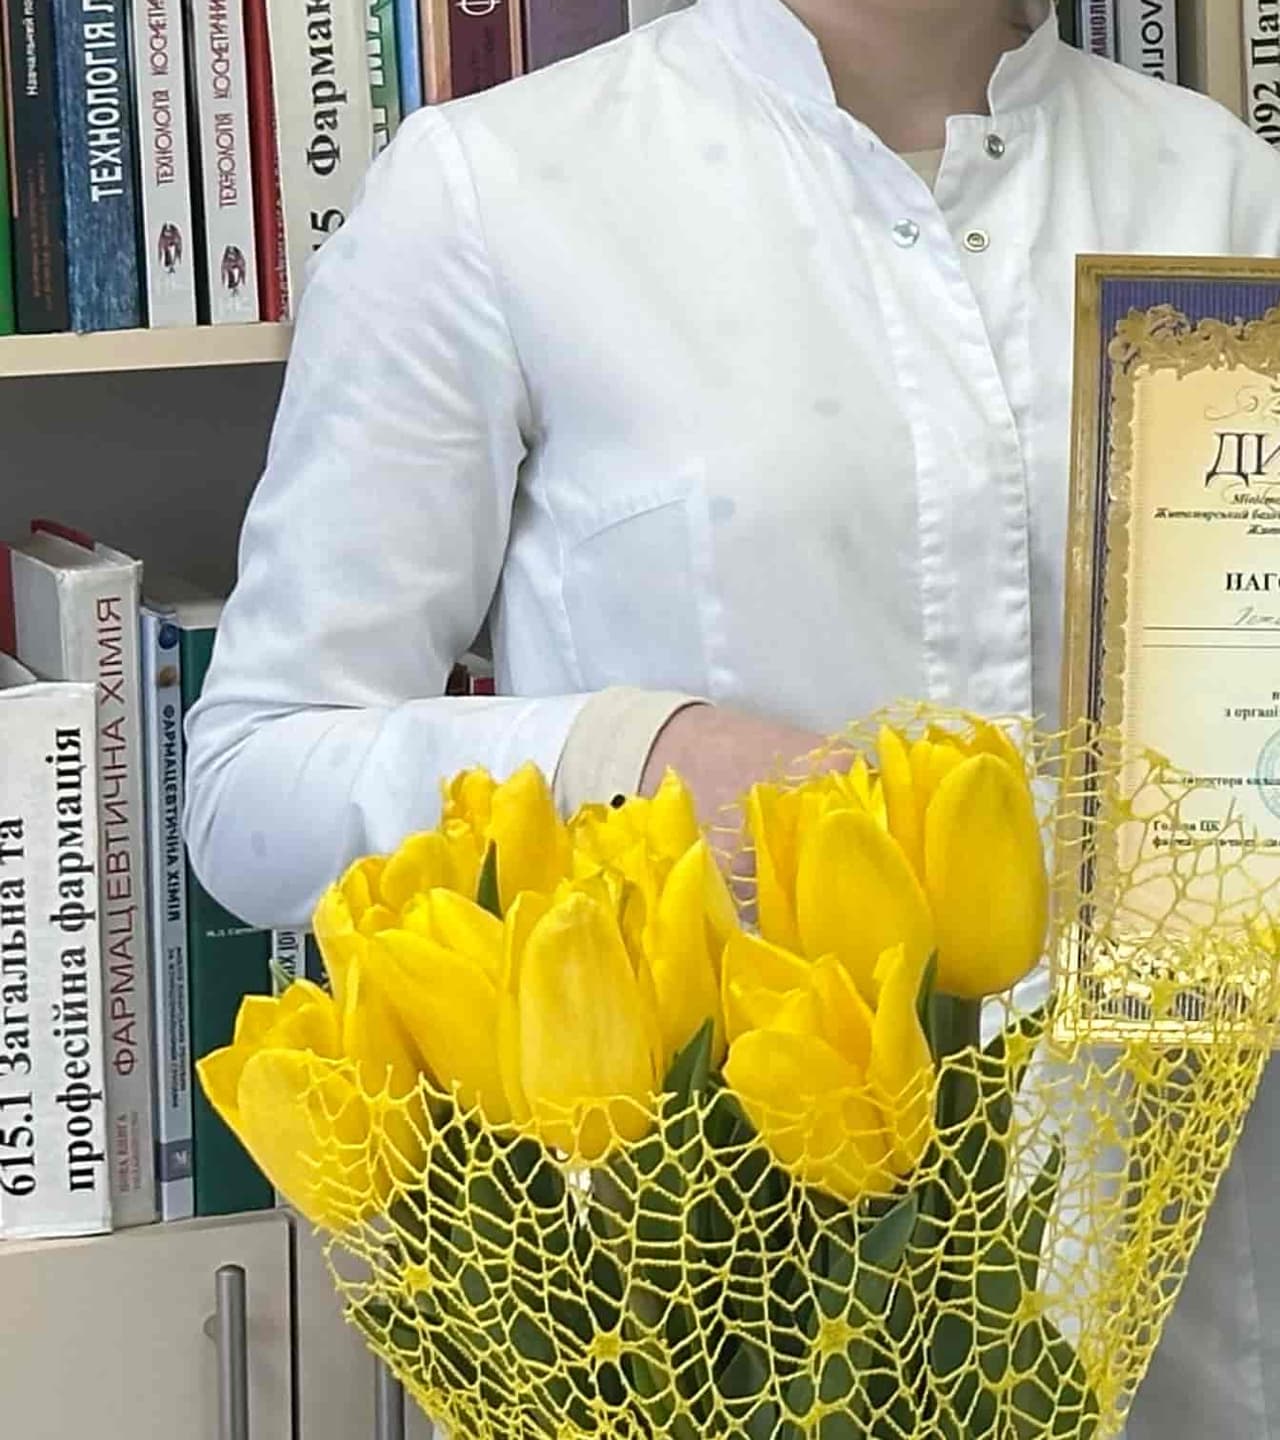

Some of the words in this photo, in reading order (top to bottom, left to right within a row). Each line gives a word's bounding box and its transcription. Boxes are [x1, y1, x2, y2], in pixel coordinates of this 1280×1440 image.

[83, 22, 124, 203] ТЕХНОЛОГІЯ
[153, 90, 174, 184] ТЕХНОЛОГІЯ
[215, 113, 237, 208] ТЕХНОЛОГІЯ
[96, 596, 123, 707] ХІМІЯ
[46, 727, 95, 932] фармація
[161, 705, 180, 866] ФАРМАЦЕВТИЧНА
[100, 717, 138, 1077] ФАРМАЦЕВТИЧНА
[166, 870, 181, 922] ХІМІЯ
[51, 946, 102, 1192] професійна
[1, 1092, 37, 1197] 615.1
